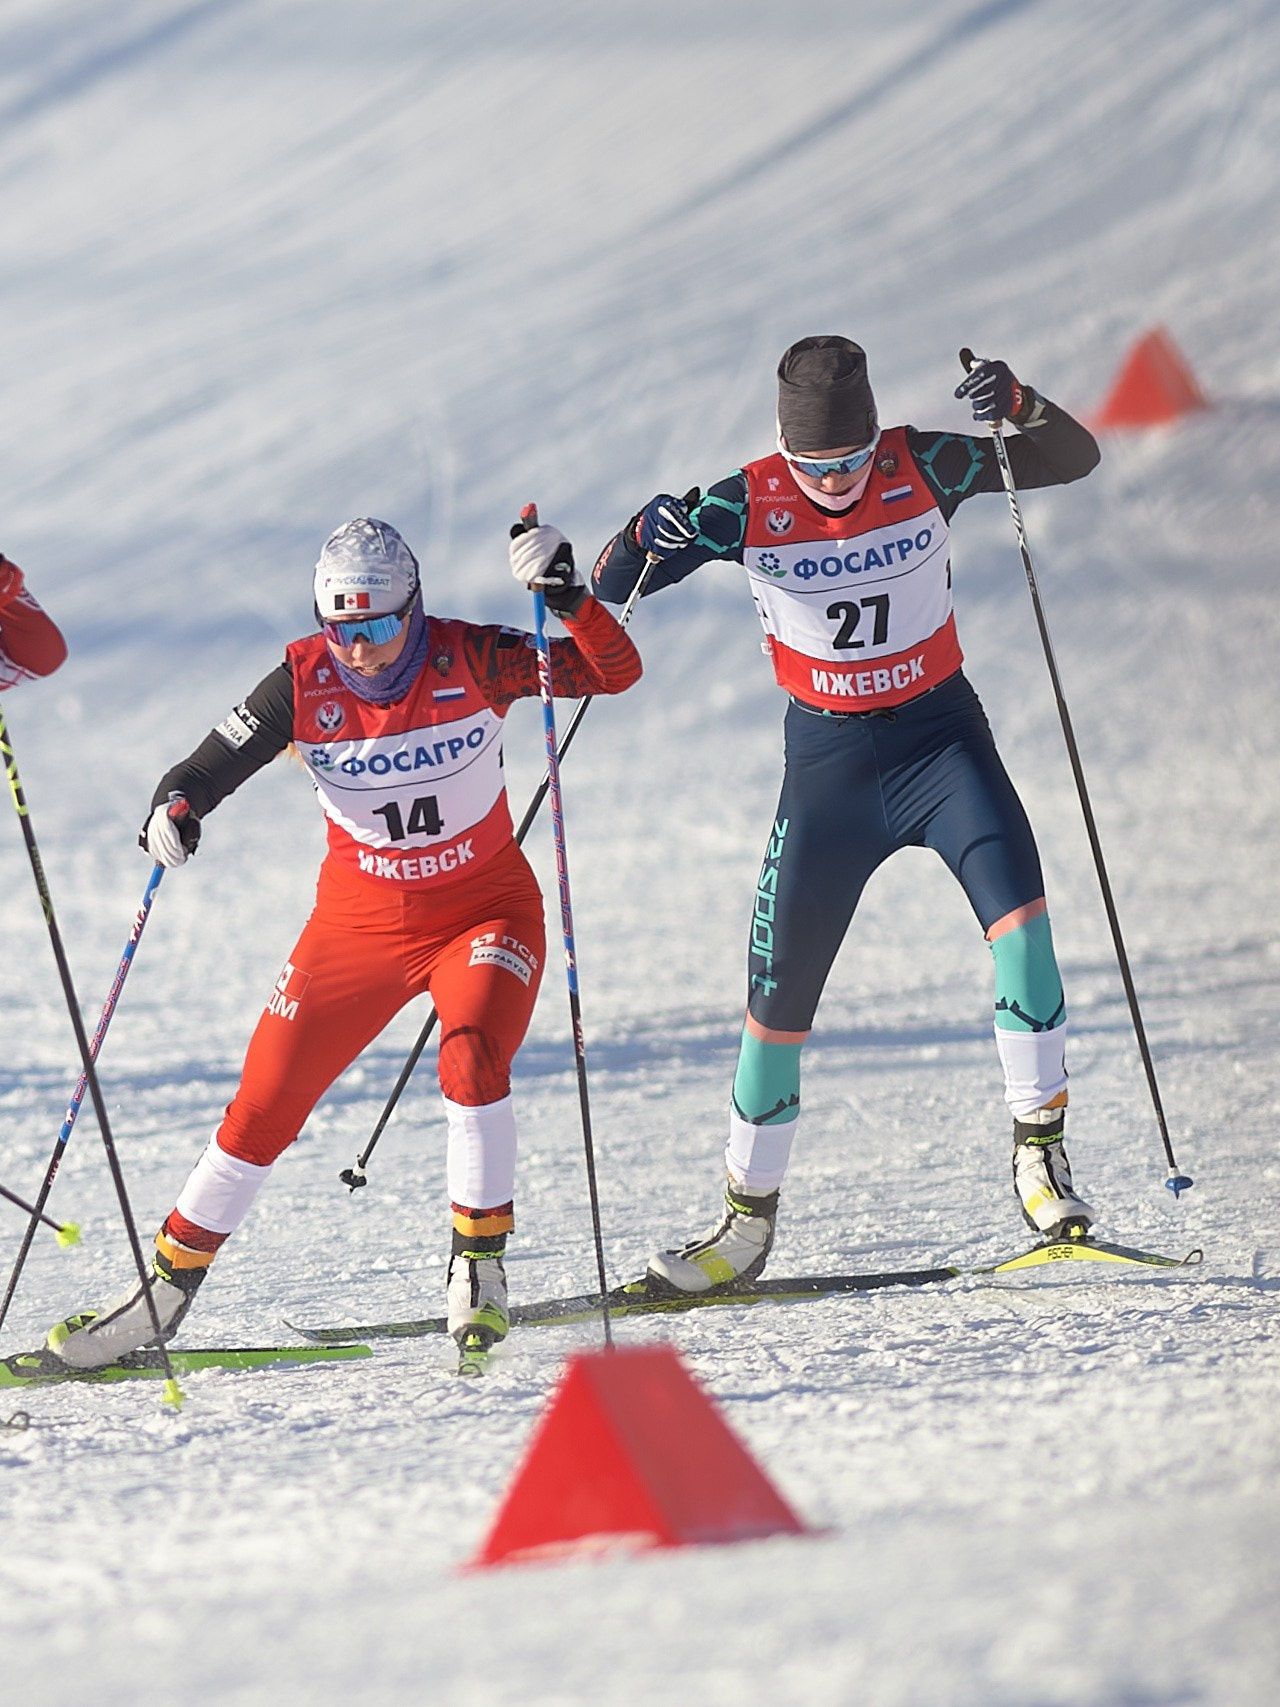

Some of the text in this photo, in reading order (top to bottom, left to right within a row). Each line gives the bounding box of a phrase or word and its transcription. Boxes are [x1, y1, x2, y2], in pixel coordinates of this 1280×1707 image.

[793, 528, 932, 580] ФОСАГРО
[826, 593, 890, 650] 27
[811, 655, 925, 696] ИЖЕВСК
[341, 727, 484, 776] ФОСАГРО
[372, 795, 444, 842] 14
[358, 839, 475, 880] ИЖЕВСК
